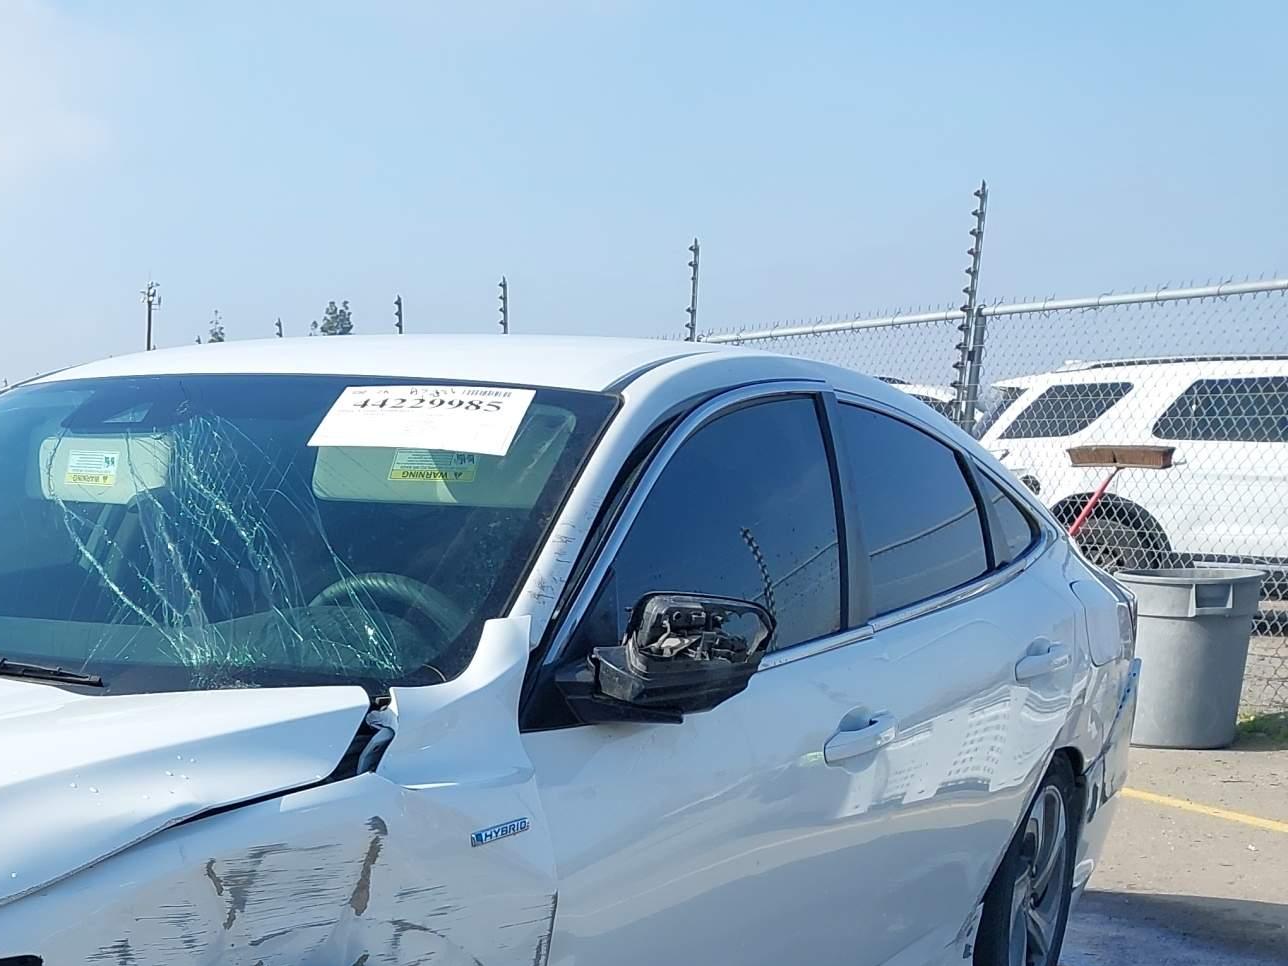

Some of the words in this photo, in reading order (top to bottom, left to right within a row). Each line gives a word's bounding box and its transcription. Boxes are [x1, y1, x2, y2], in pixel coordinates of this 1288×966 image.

[352, 398, 503, 413] 44229985
[401, 470, 449, 480] WARNING
[484, 820, 527, 842] HYBRID
